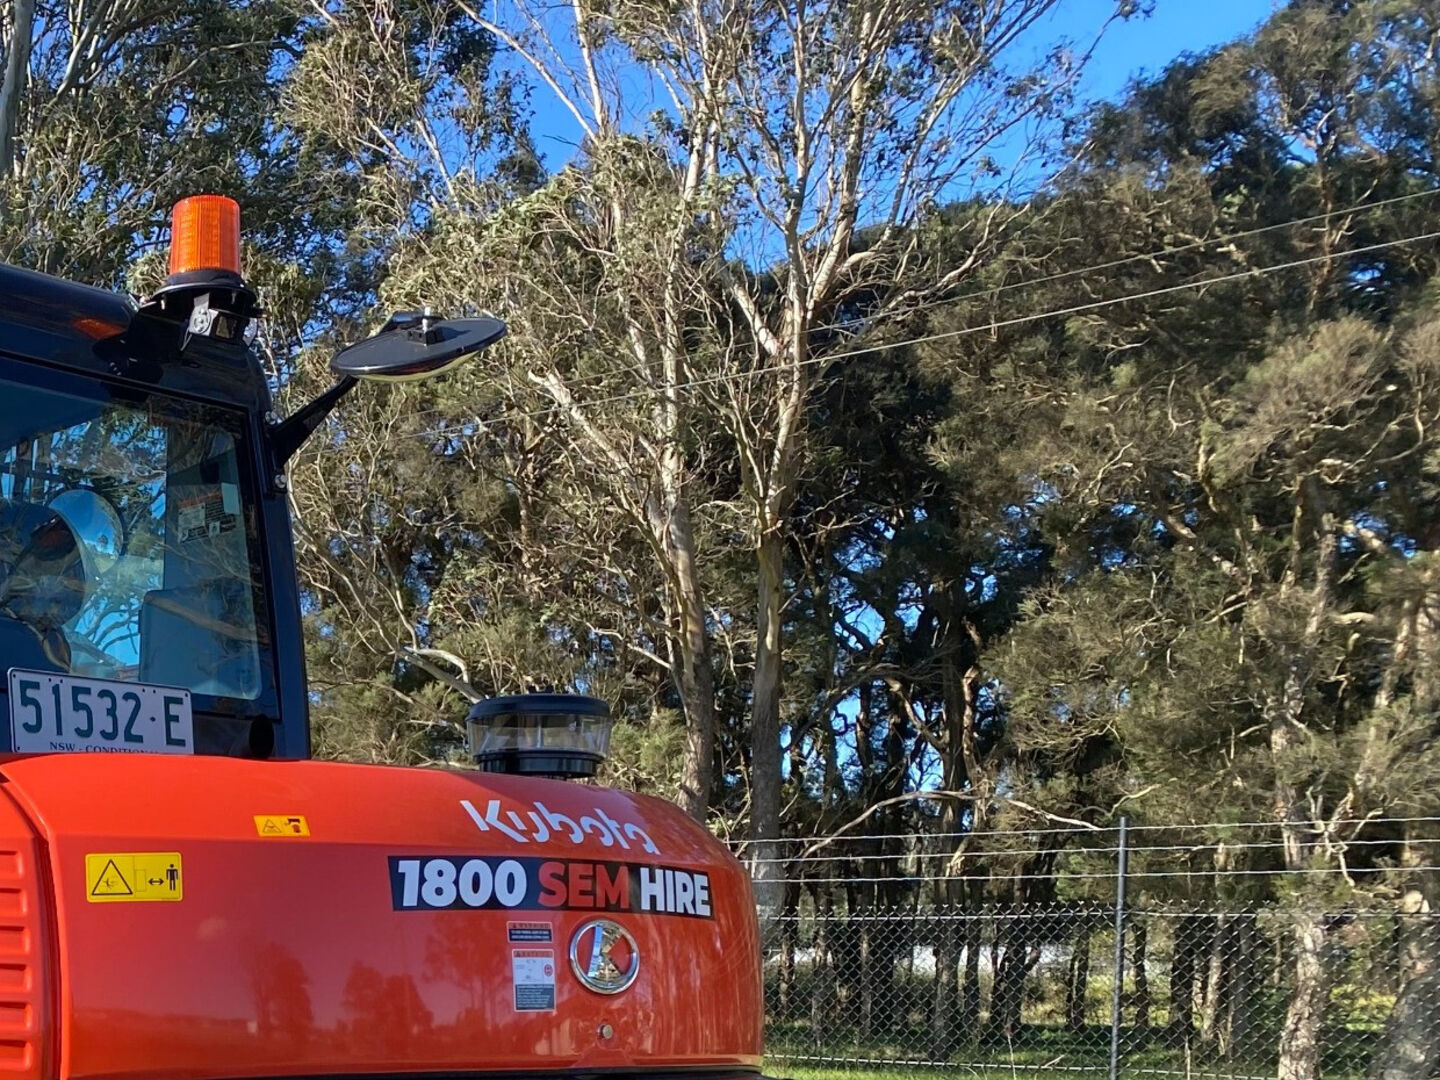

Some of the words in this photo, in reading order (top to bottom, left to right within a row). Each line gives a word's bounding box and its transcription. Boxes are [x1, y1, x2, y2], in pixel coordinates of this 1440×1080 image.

[49, 741, 75, 752] NSW
[460, 799, 661, 856] Kubota
[397, 858, 528, 908] 1800
[537, 861, 630, 910] SEM
[639, 866, 711, 917] HIRE
